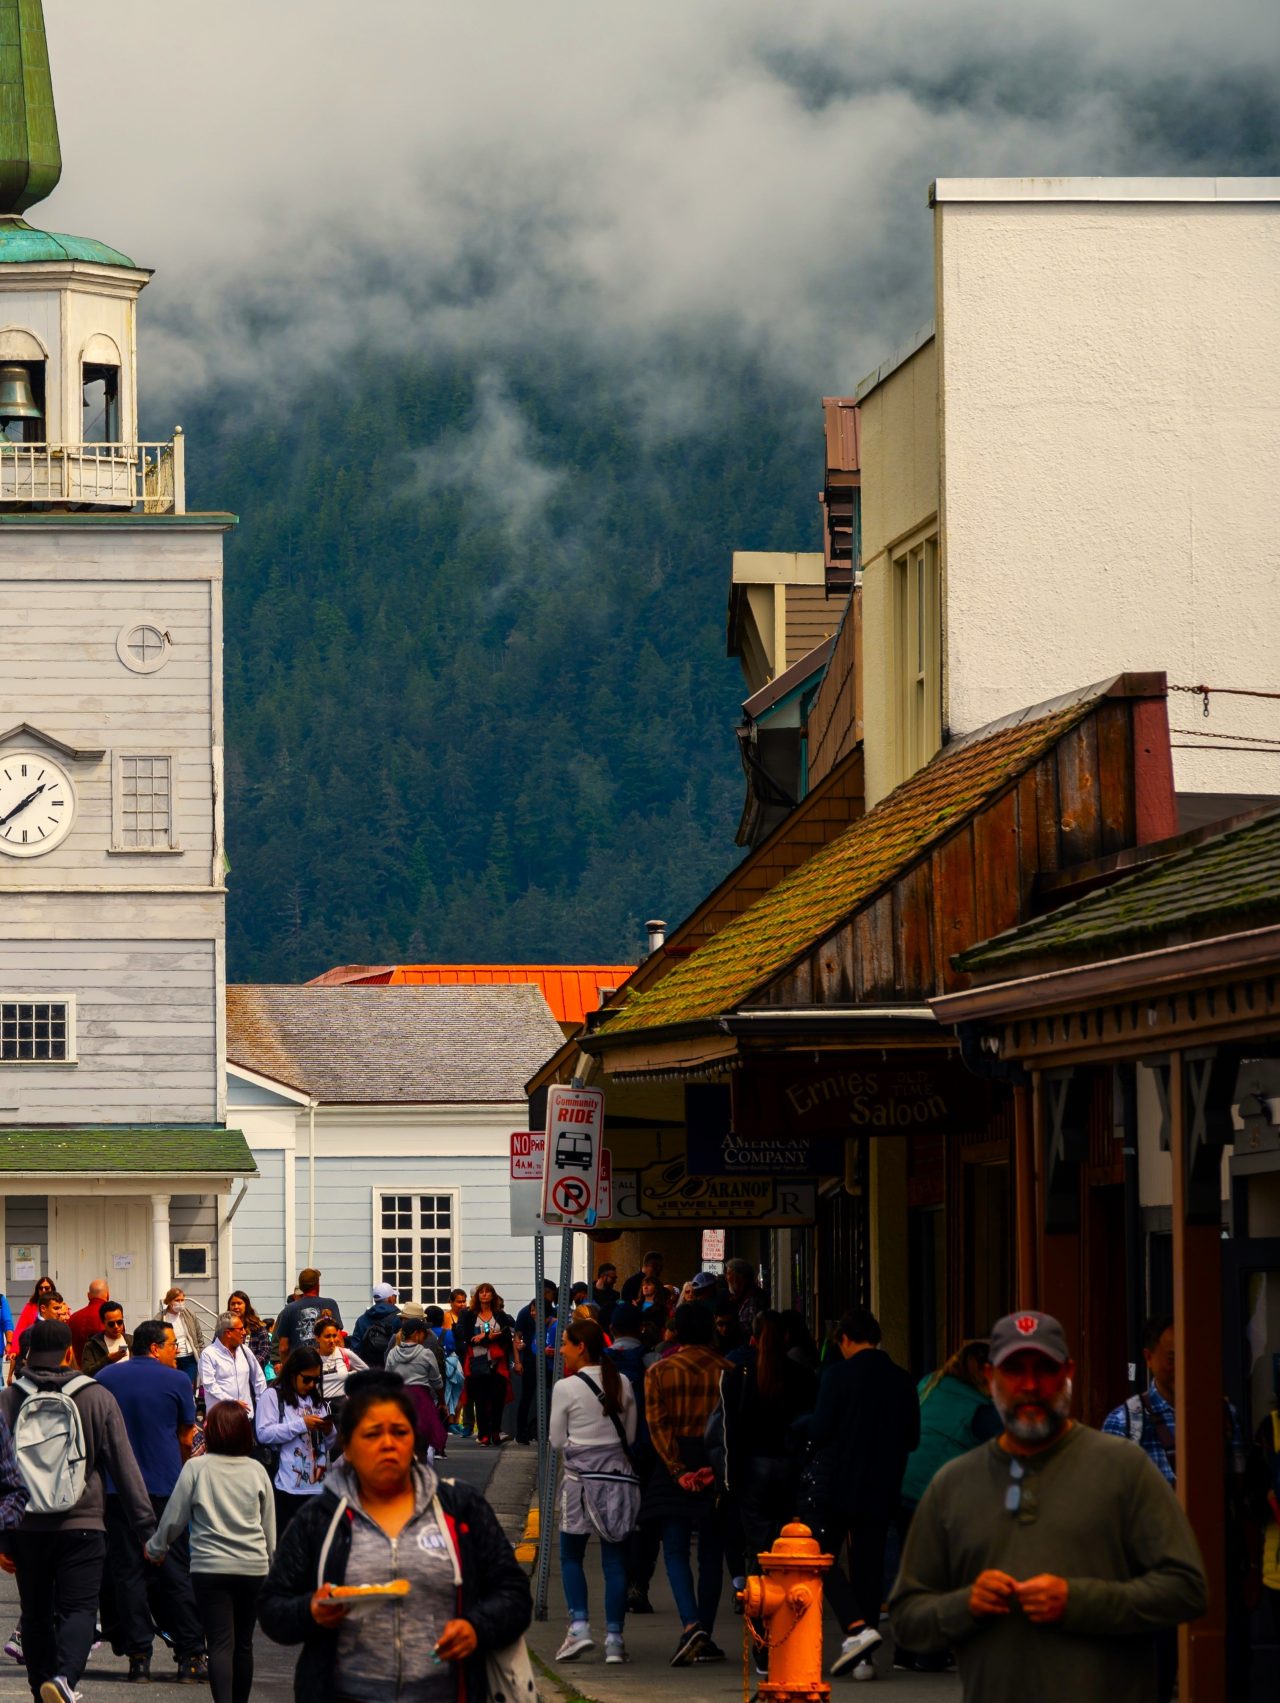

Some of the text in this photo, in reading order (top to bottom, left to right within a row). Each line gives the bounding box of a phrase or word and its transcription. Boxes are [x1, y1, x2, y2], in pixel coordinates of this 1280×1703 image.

[896, 1071, 928, 1083] OLD
[890, 1083, 933, 1097] TIME
[556, 1094, 598, 1109] Community
[558, 1108, 596, 1124] RIDE
[849, 1095, 948, 1126] Saloon
[513, 1135, 529, 1154] NO
[720, 1132, 810, 1149] AMERICAN
[723, 1148, 807, 1164] COMPANY
[657, 1200, 755, 1208] JEWELERS
